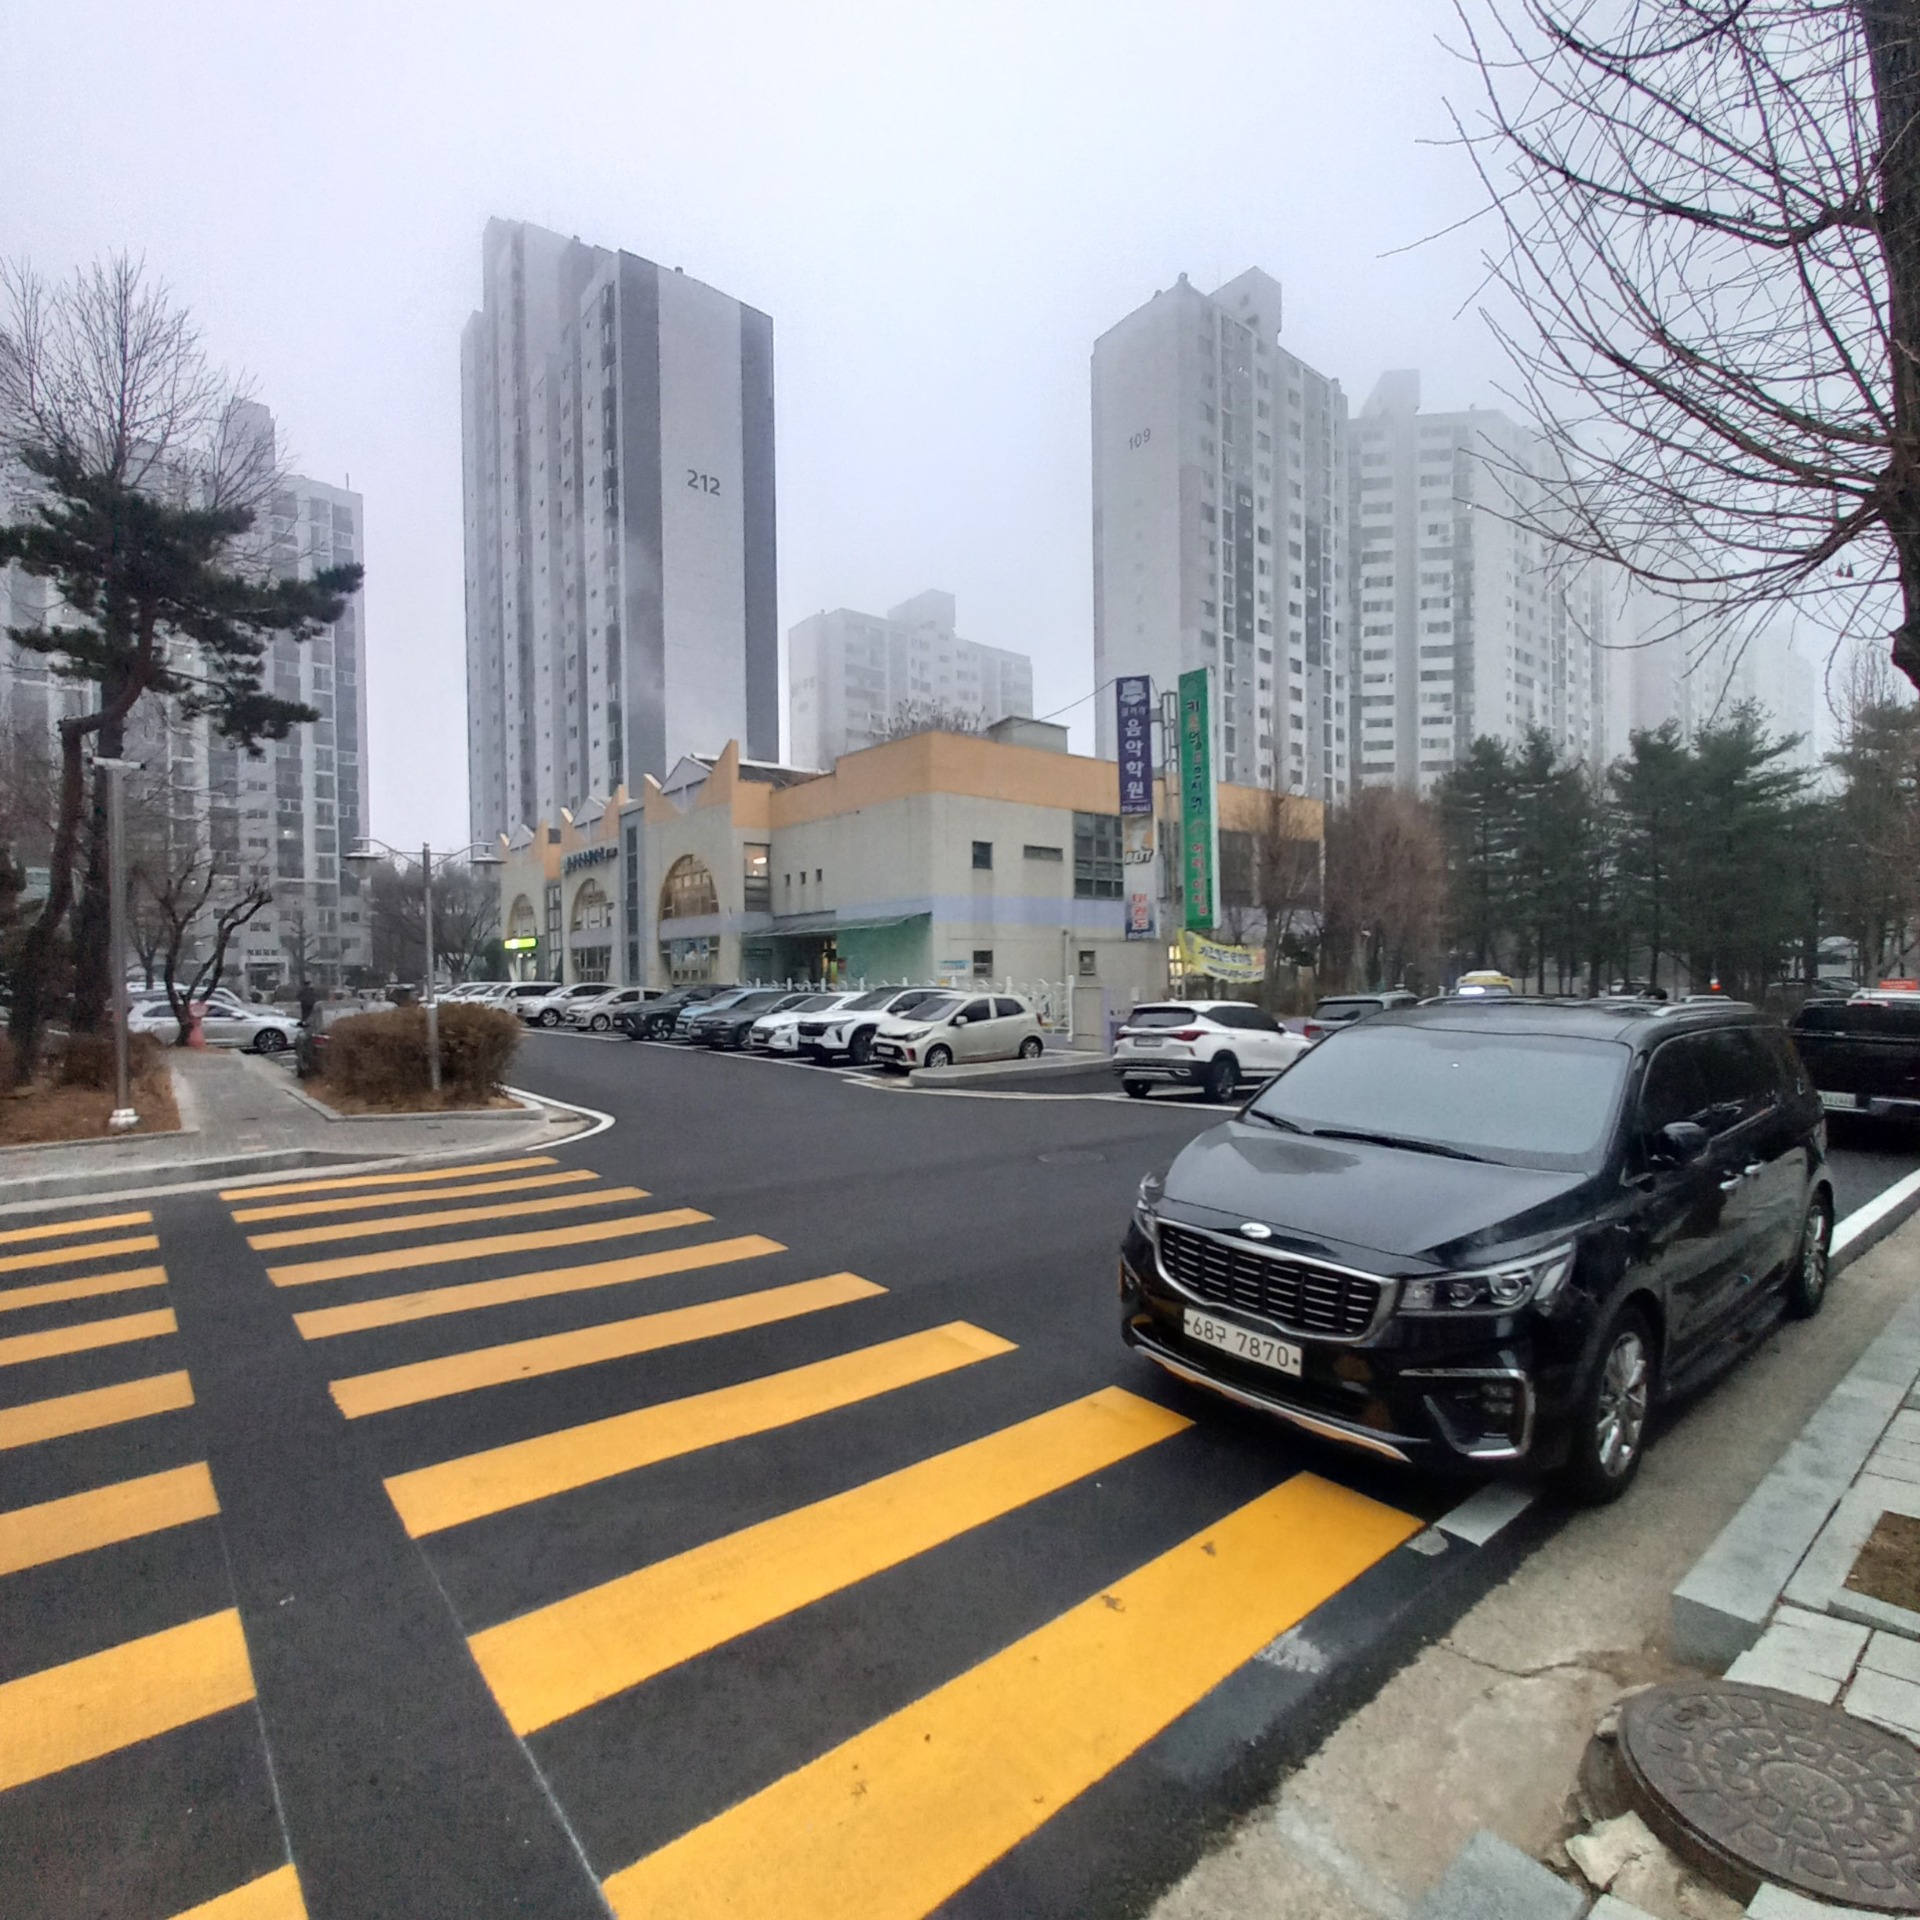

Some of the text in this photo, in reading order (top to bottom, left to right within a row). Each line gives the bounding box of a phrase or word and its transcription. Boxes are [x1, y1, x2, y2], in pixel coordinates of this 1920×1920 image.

[1129, 427, 1151, 451] 109
[687, 469, 721, 496] 212
[1124, 718, 1145, 800] 음악학원
[1235, 1331, 1289, 1368] 7870
